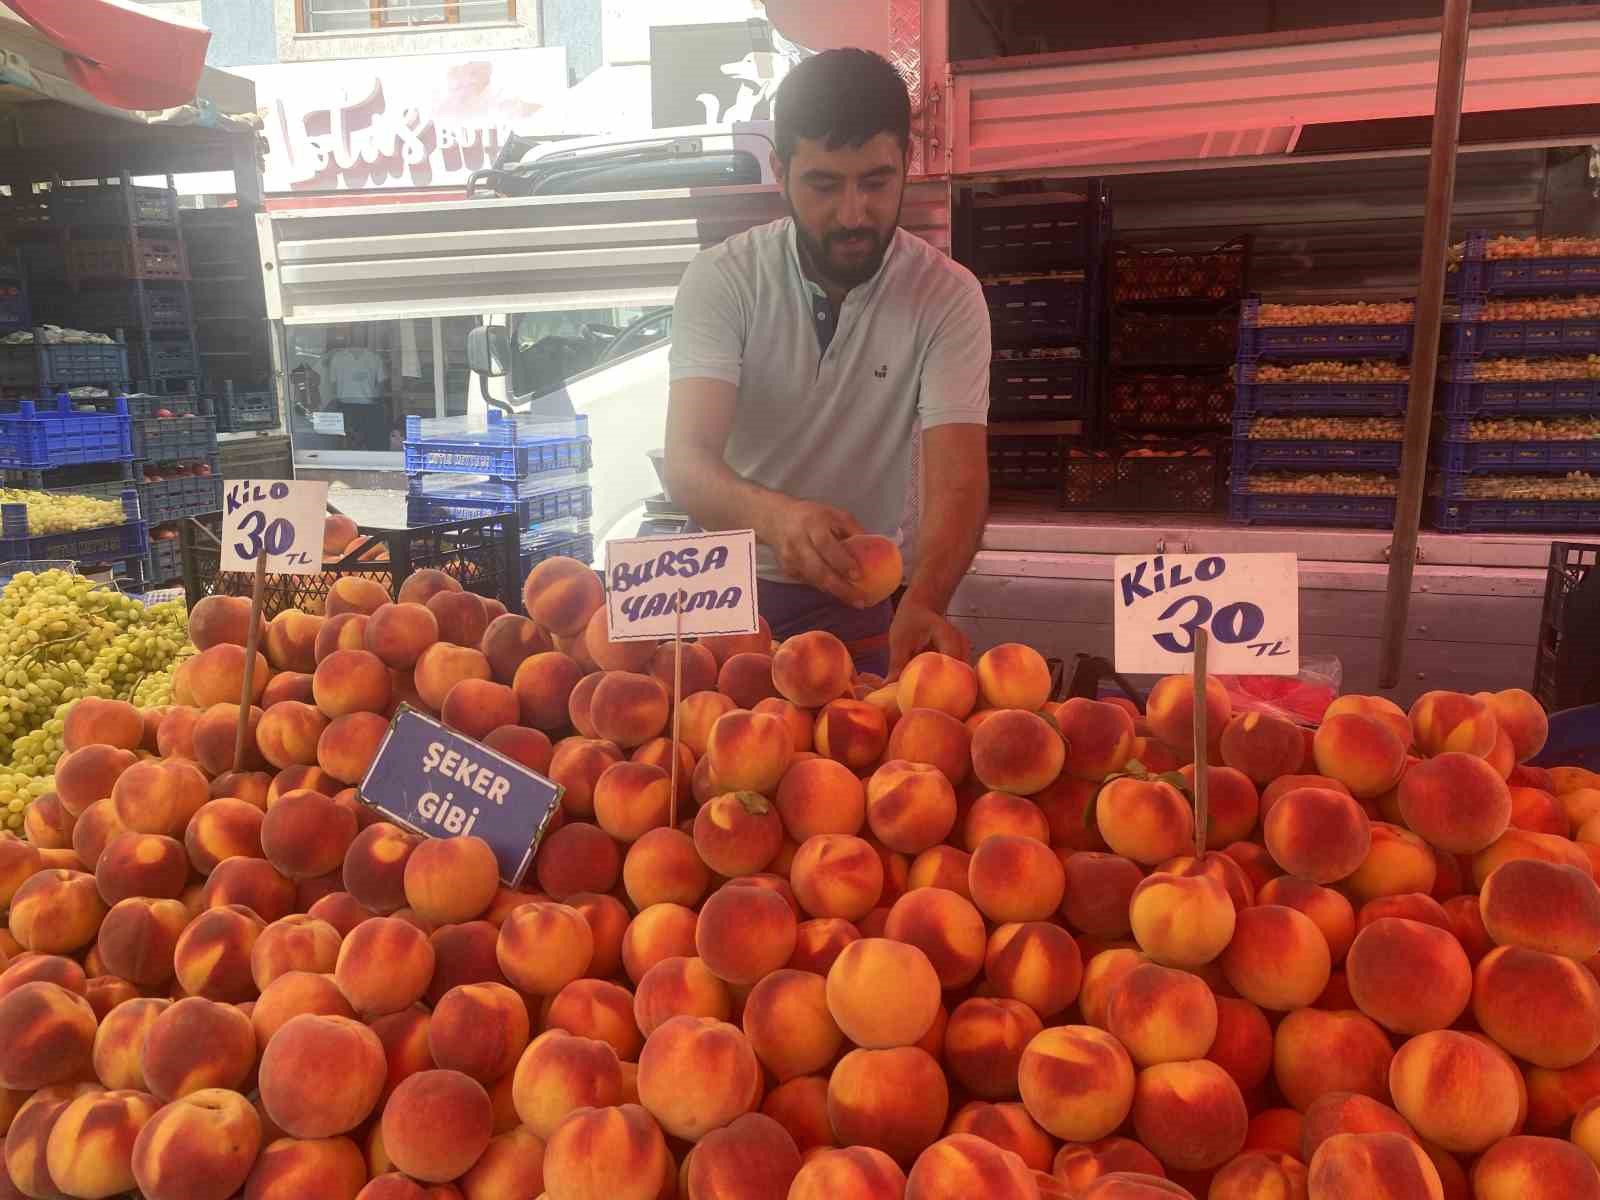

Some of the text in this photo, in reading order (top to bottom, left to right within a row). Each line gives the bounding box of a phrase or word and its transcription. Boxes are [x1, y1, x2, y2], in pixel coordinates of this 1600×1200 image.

[233, 510, 313, 565] 30 TL
[612, 546, 729, 593] BURSA
[620, 586, 743, 622] YARMA
[1152, 595, 1291, 657] 30 TL
[423, 742, 511, 805] ŞEKER
